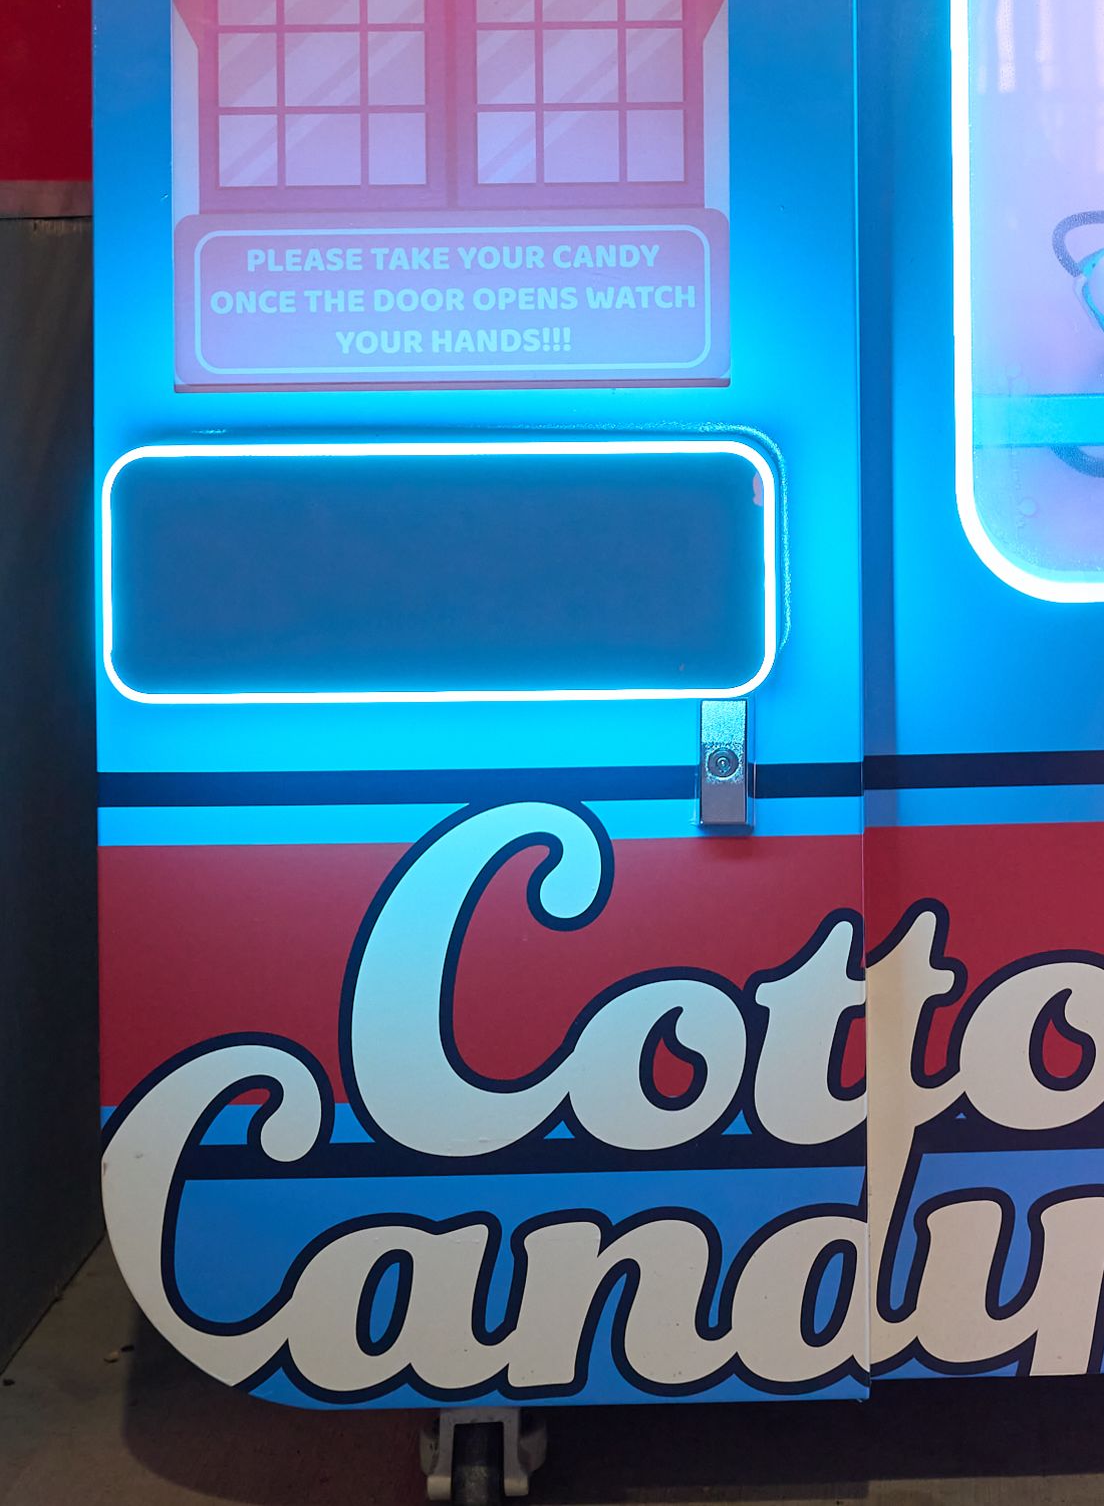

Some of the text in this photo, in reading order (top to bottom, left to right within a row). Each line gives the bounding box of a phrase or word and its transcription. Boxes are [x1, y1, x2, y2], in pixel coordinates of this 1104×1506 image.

[247, 243, 661, 273] PLEASE TAKE YOUR CANDY
[209, 284, 696, 314] ONCE THE DOOR OPENS WATCH
[335, 326, 573, 355] YOUR HANDS!!!
